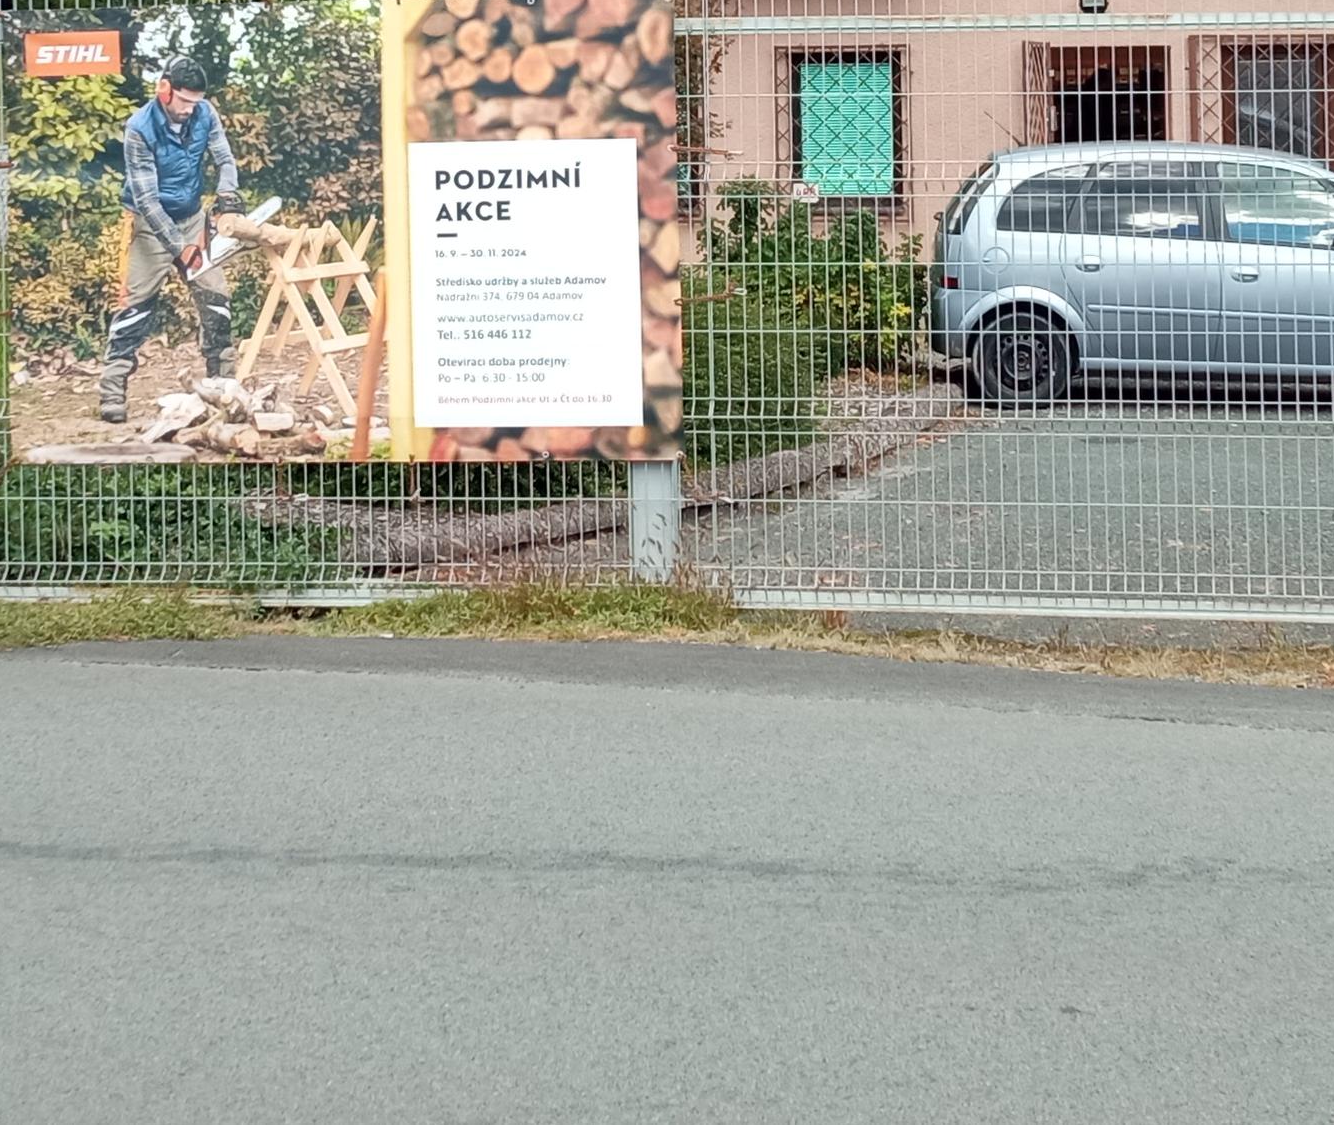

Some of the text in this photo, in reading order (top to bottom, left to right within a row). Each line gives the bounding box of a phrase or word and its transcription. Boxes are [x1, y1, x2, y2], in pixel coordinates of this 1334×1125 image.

[35, 44, 110, 64] STIHL
[435, 161, 581, 190] PODZIMNÍ
[435, 201, 511, 221] AKCE
[501, 249, 527, 257] 2024
[564, 276, 606, 285] Adamov
[506, 291, 524, 300] 679
[527, 291, 539, 300] 04
[542, 291, 583, 300] Adamov
[463, 329, 484, 340] 516
[487, 329, 508, 339] 446
[512, 329, 532, 339] 112
[488, 357, 516, 367] doba
[438, 373, 451, 383] Po
